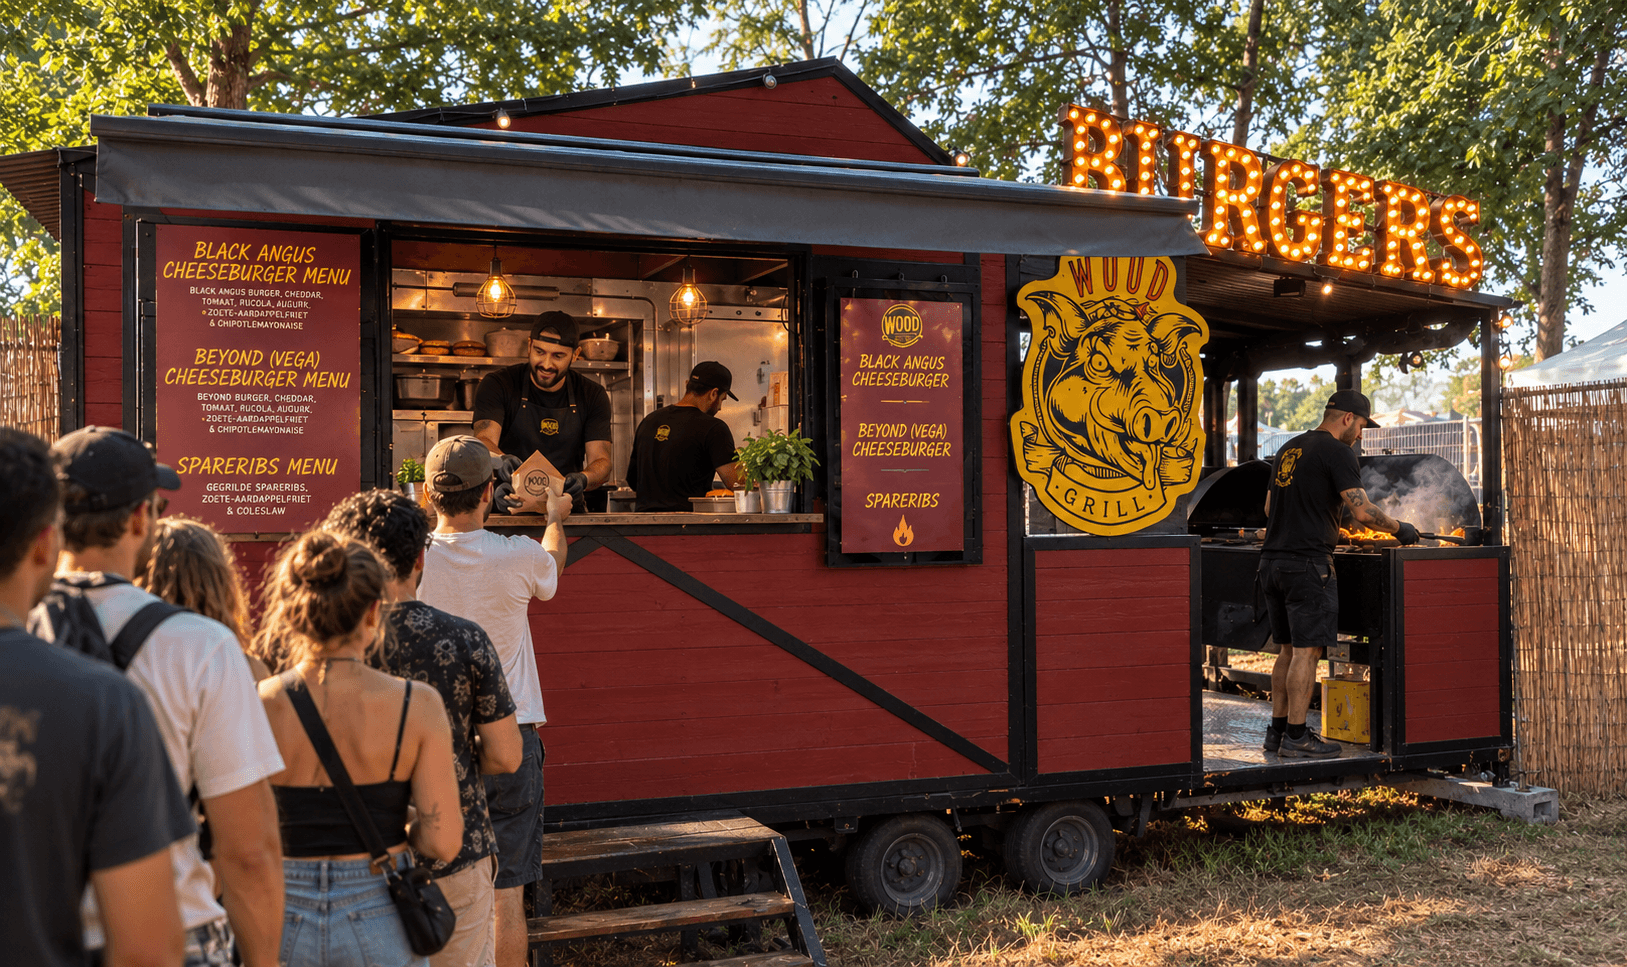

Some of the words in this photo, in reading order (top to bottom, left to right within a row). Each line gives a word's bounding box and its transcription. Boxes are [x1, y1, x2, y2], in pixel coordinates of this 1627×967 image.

[194, 241, 251, 260] BLACK
[257, 244, 316, 264] ANGUS
[163, 261, 297, 284] CHEESEBURGER
[303, 267, 351, 285] MENU
[190, 286, 216, 295] BLACK
[218, 288, 246, 296] ANGUS
[884, 315, 920, 335] WOOD
[194, 348, 263, 366] BEYOND
[269, 351, 320, 370] (VEGA)
[859, 354, 900, 369] BLACK
[904, 356, 945, 370] ANGUS
[165, 368, 297, 389] CHEESEBURGER
[303, 371, 351, 388] MENU
[852, 372, 949, 389] CHEESEBURGER
[197, 393, 232, 401] BEYOND
[858, 423, 907, 438] BEYOND
[911, 423, 947, 439] (VEGA)
[853, 442, 951, 457] CHEESEBURGER
[176, 457, 280, 475] SPARERIBS
[287, 458, 338, 475] MENU
[206, 483, 252, 492] GEGRILDE
[202, 495, 311, 503] ZOETE-AARDAPPELFRIET
[865, 493, 940, 508] SPARERIBS
[1063, 487, 1146, 518] GRILL
[227, 506, 234, 515] &
[237, 506, 286, 516] COLESLAW
